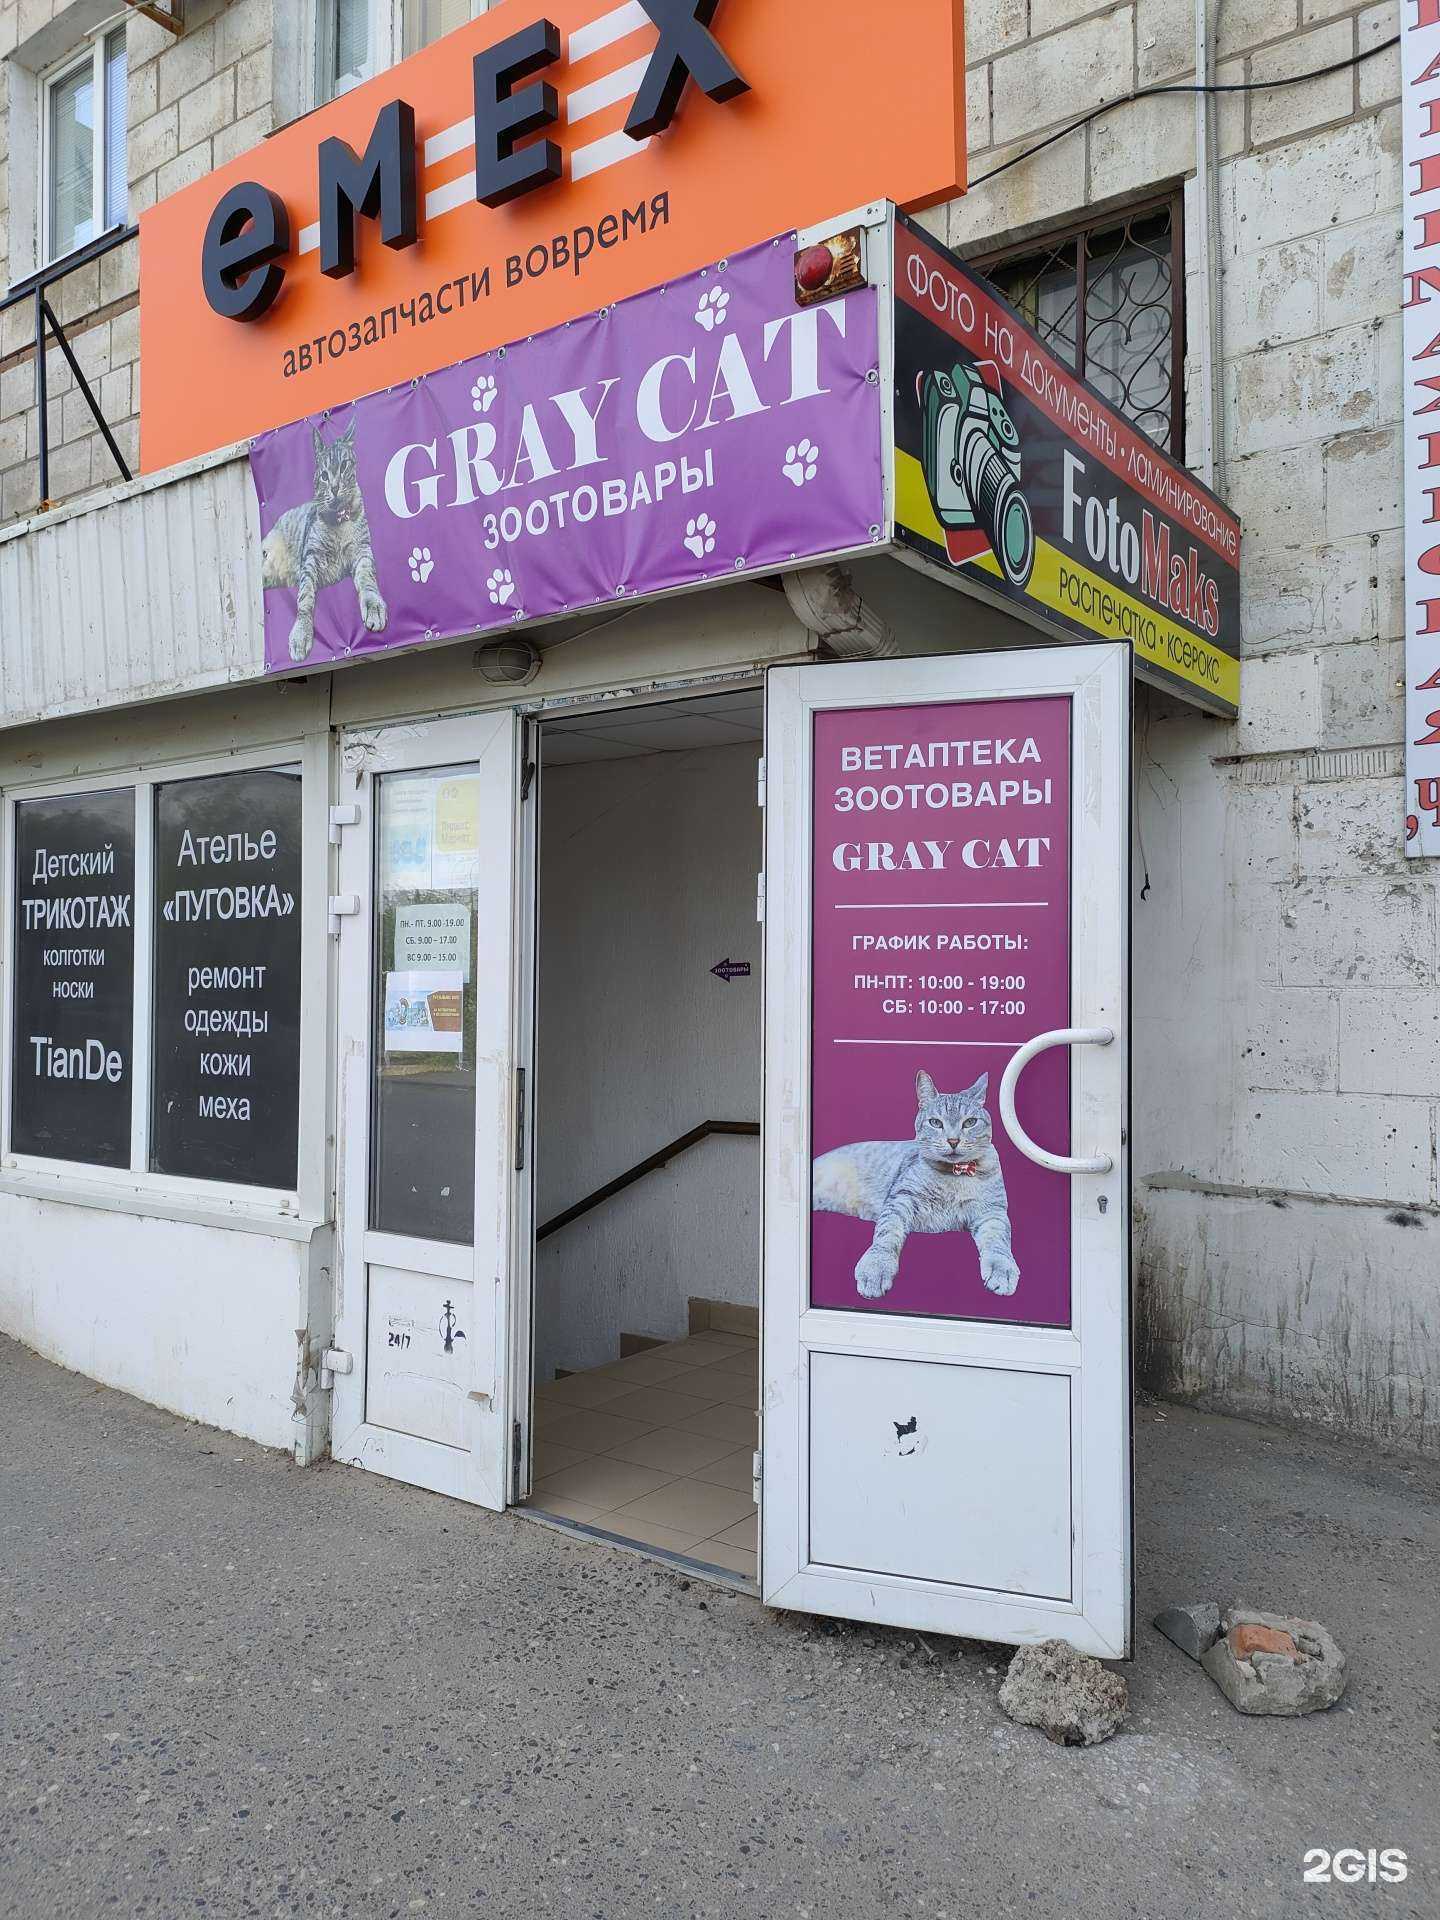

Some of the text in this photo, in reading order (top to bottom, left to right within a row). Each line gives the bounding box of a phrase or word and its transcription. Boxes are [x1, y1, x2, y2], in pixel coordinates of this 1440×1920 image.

[282, 190, 671, 378] автозапчасти вовремя
[383, 297, 847, 519] GRAY CAT
[481, 448, 716, 551] ЗООТОВАРЫ
[841, 737, 1042, 772] ВЕТАПТЕКА
[834, 778, 1052, 812] ЗООТОВАРЫ
[32, 842, 115, 886] Детский
[177, 828, 277, 867] Ателье
[832, 837, 1050, 873] GRAY CAT
[22, 894, 132, 930] ТРИКОТАЖ
[162, 884, 296, 922] «ПУГОВКА»
[852, 934, 1030, 951] ГРАФИК РАБОТЫ:
[188, 966, 267, 996] ремонт
[853, 975, 914, 990] ПН-ПТ:
[918, 975, 964, 990] 10:00
[979, 975, 1026, 990] 19:00
[184, 1009, 268, 1038] одежды
[882, 999, 914, 1015] СБ:
[918, 999, 964, 1015] 10:00
[979, 1000, 1026, 1016] 17:00
[30, 1036, 122, 1083] TianDe
[200, 1052, 251, 1077] кожи
[199, 1095, 251, 1121] меха
[388, 1331, 411, 1350] 24/7
